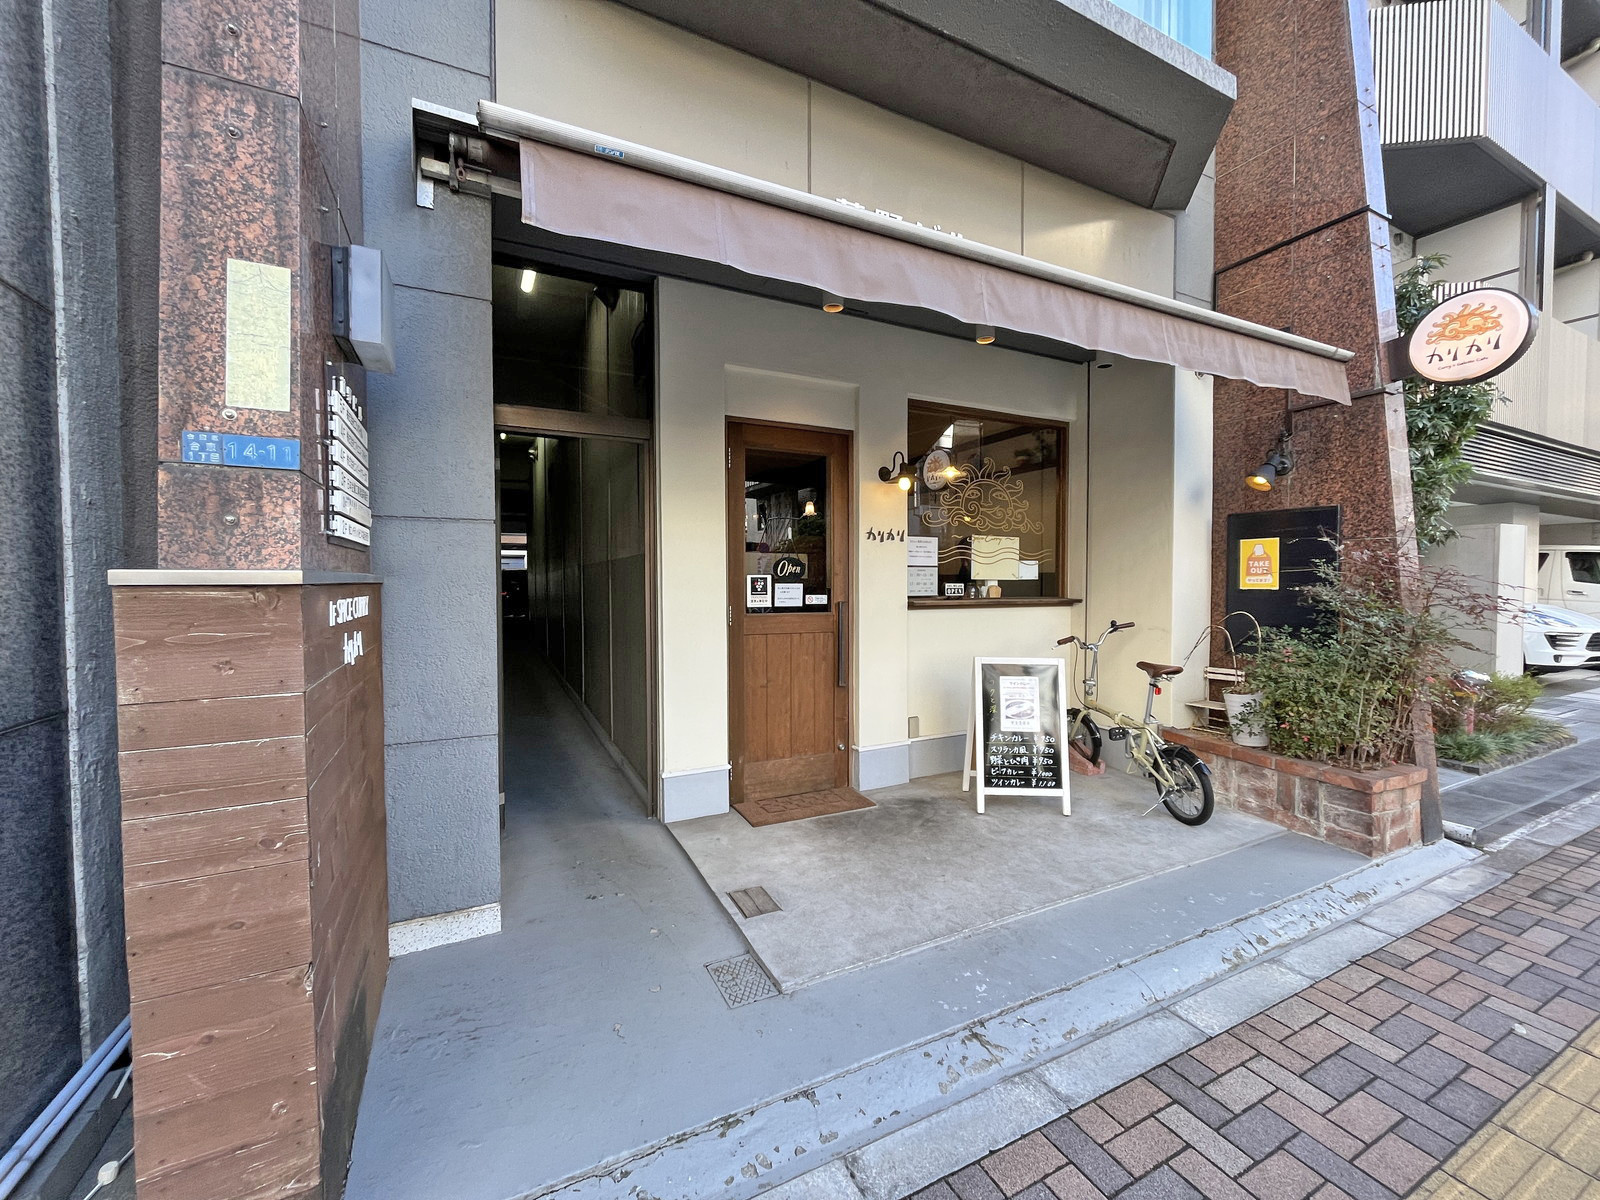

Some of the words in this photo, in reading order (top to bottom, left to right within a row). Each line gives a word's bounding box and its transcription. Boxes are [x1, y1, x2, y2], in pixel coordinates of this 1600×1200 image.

[227, 441, 292, 462] 14-11
[777, 560, 801, 577] Open
[990, 733, 1029, 742] チキンカレー
[990, 745, 1029, 754] スリランカ風
[991, 778, 1026, 786] ツインカレー
